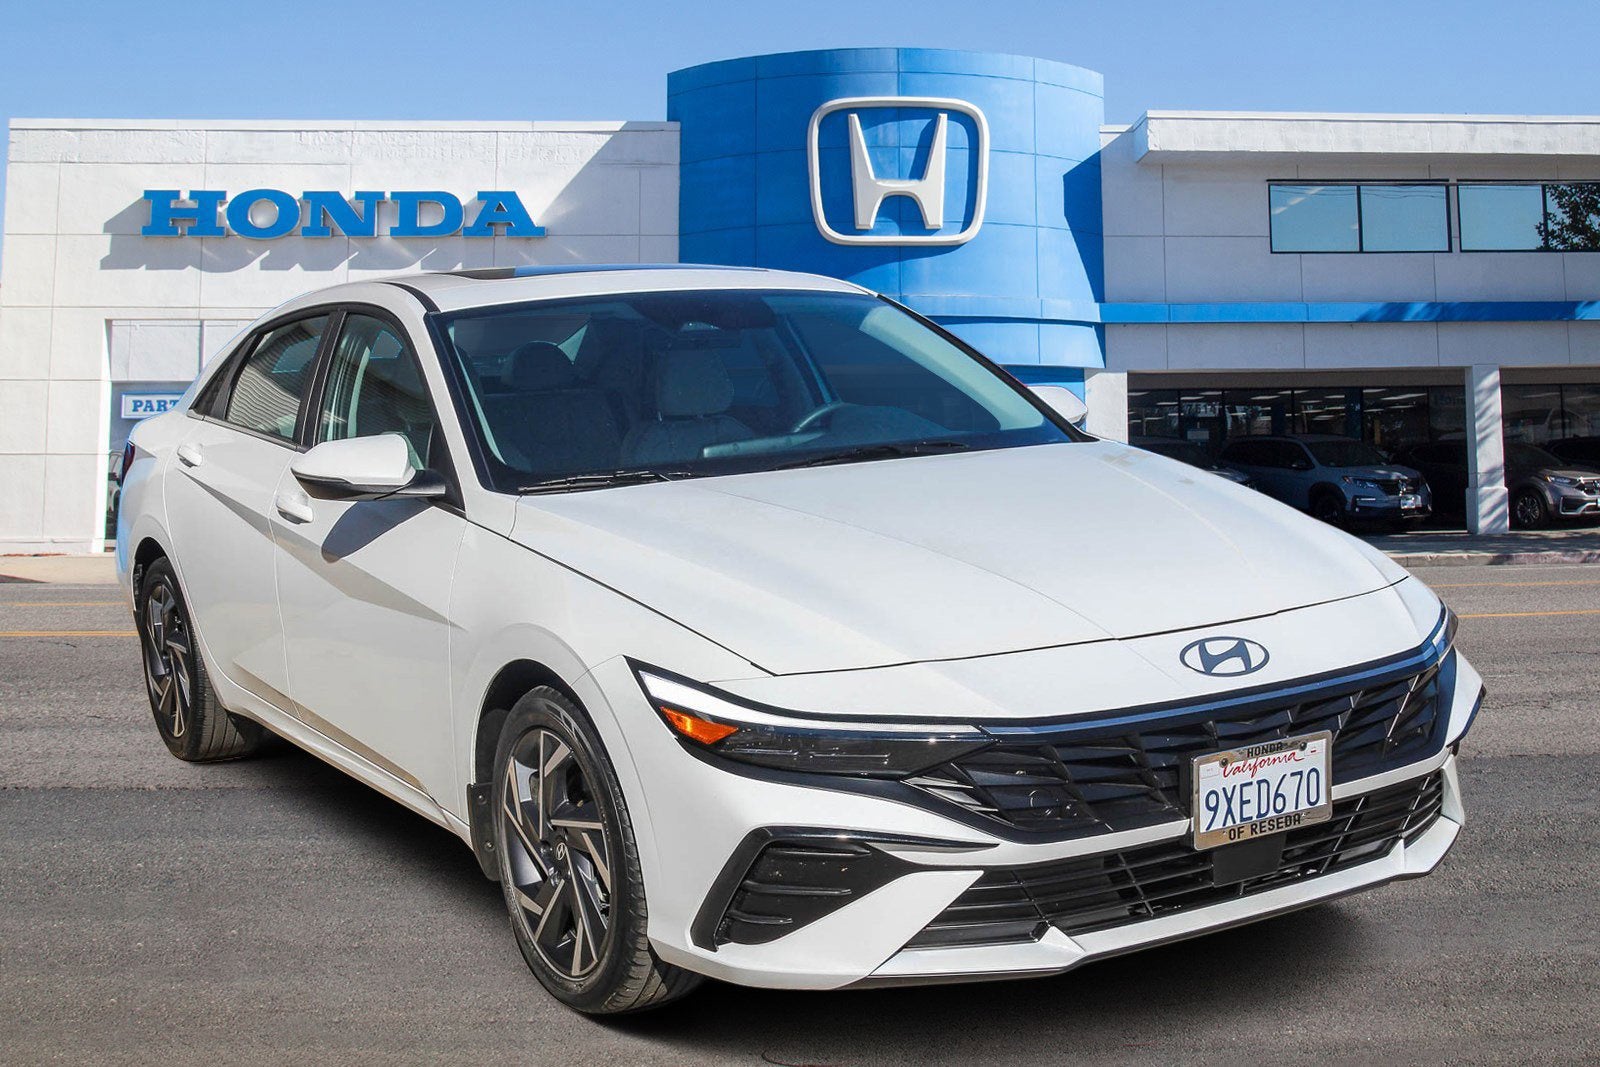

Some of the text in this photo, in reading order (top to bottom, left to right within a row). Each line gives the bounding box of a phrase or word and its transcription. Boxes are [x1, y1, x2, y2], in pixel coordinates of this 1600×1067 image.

[141, 189, 547, 240] HONDA
[1246, 742, 1284, 758] HONDA
[1222, 751, 1304, 778] California
[1205, 767, 1320, 832] 9XED670
[1228, 814, 1301, 841] OF RESEDA
